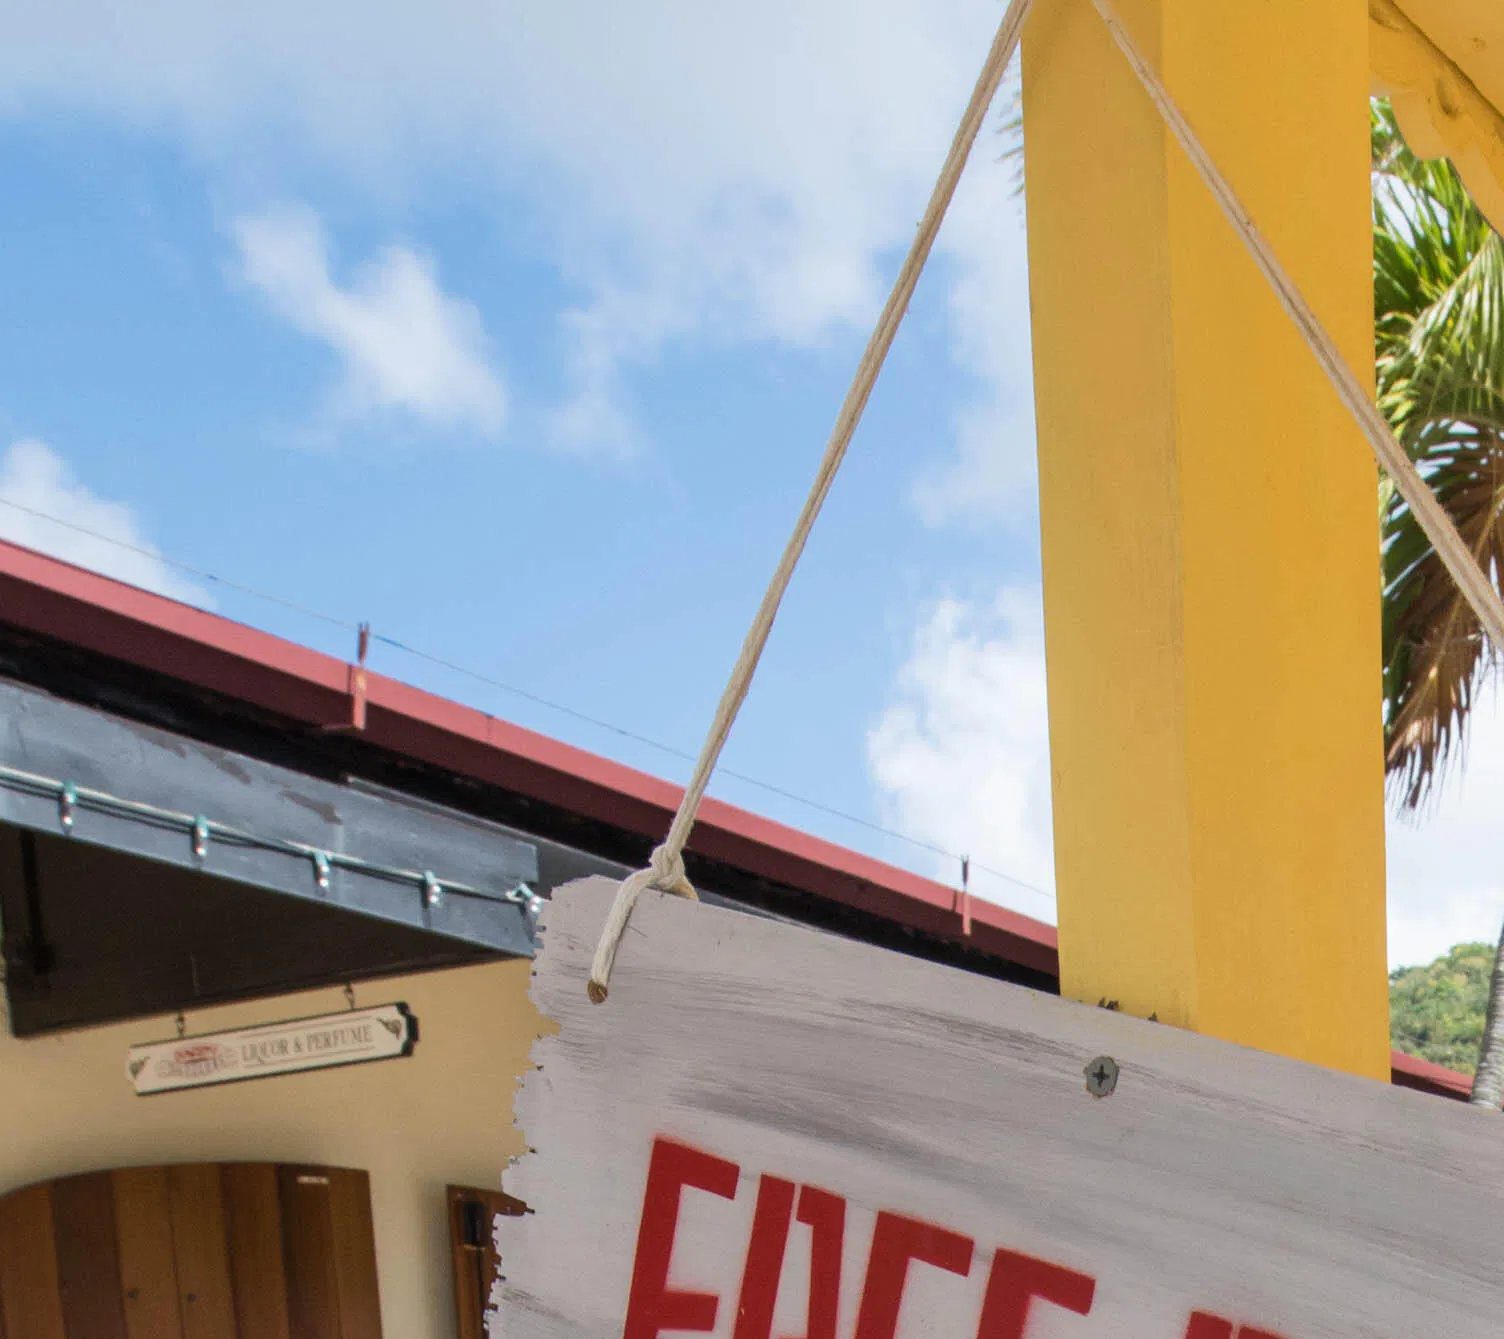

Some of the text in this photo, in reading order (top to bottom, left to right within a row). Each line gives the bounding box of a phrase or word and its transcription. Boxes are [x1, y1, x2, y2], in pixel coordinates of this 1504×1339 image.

[240, 1042, 290, 1065] LIQUOR
[294, 1037, 303, 1053] &
[306, 1025, 373, 1052] PERFUME
